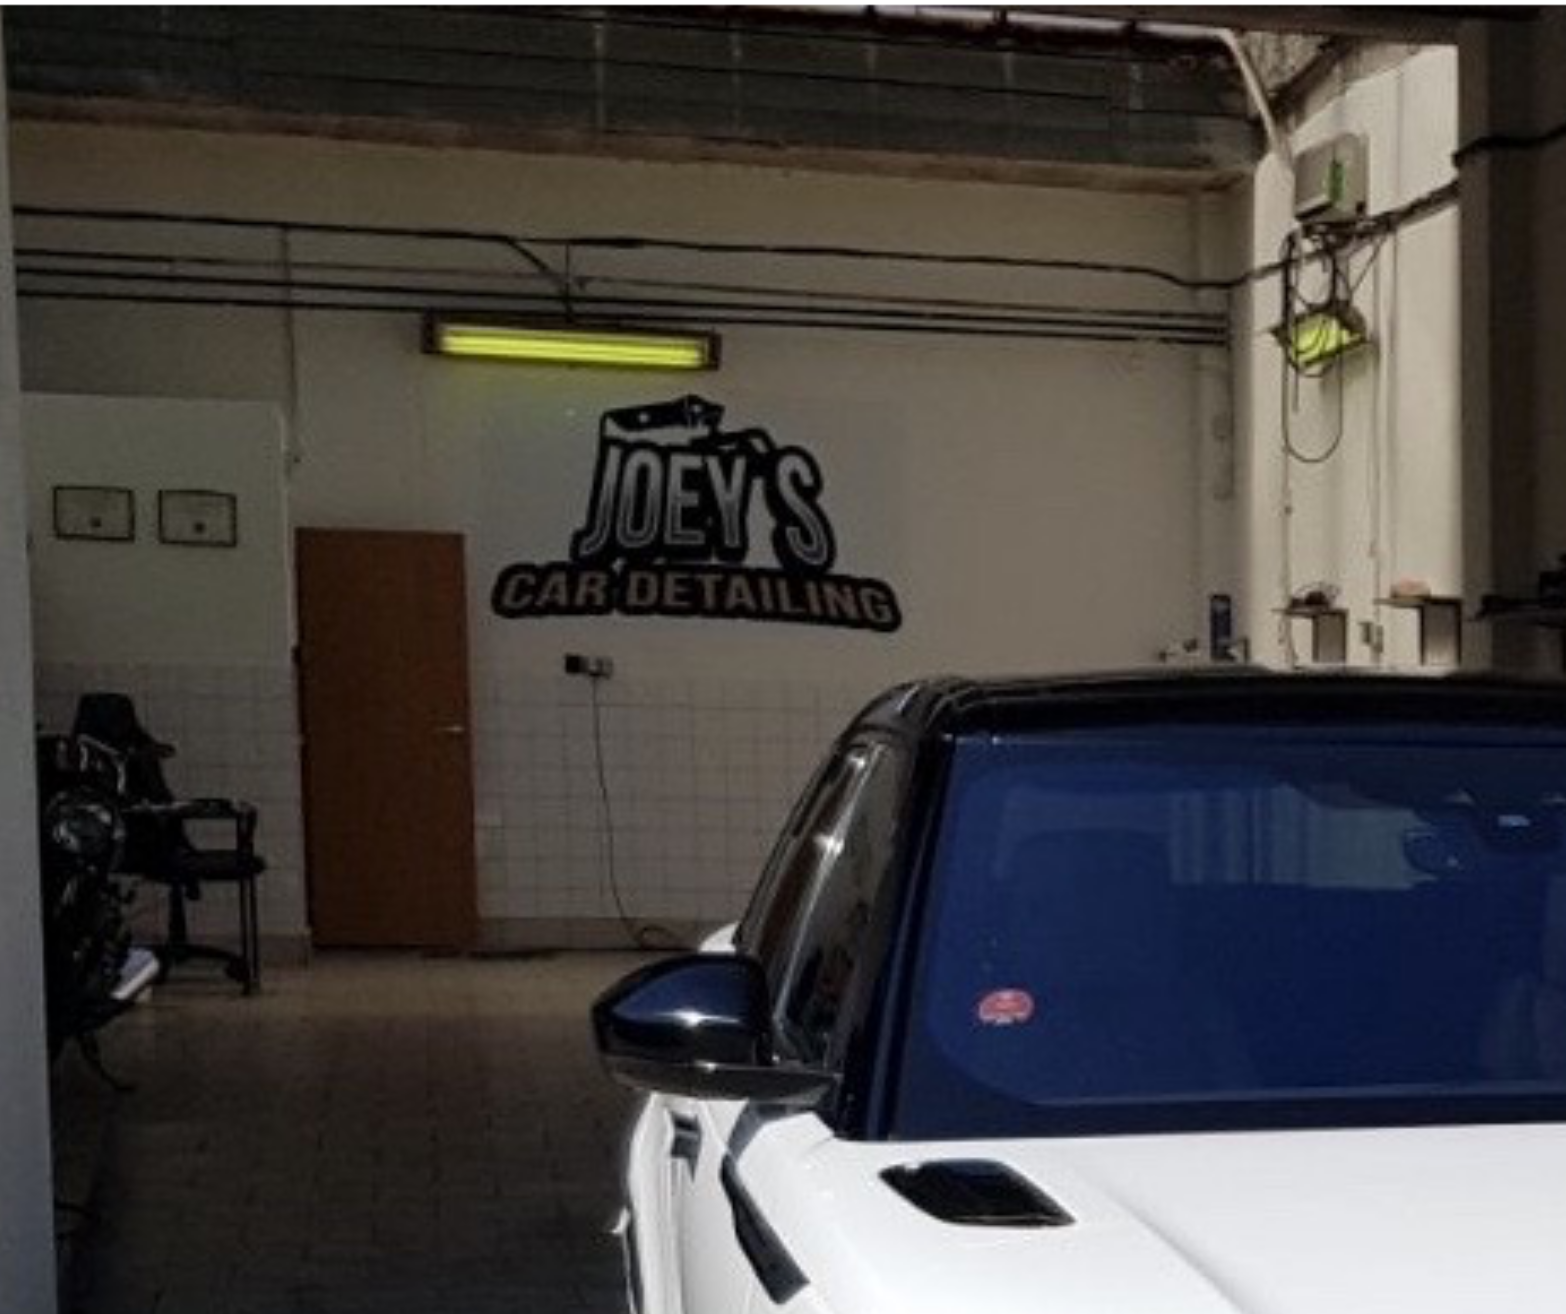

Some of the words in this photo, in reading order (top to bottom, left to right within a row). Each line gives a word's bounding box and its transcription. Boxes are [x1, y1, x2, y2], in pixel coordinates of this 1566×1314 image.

[578, 437, 831, 567] JOEY'S
[500, 569, 609, 608] CAR
[625, 569, 896, 624] DETAILING
